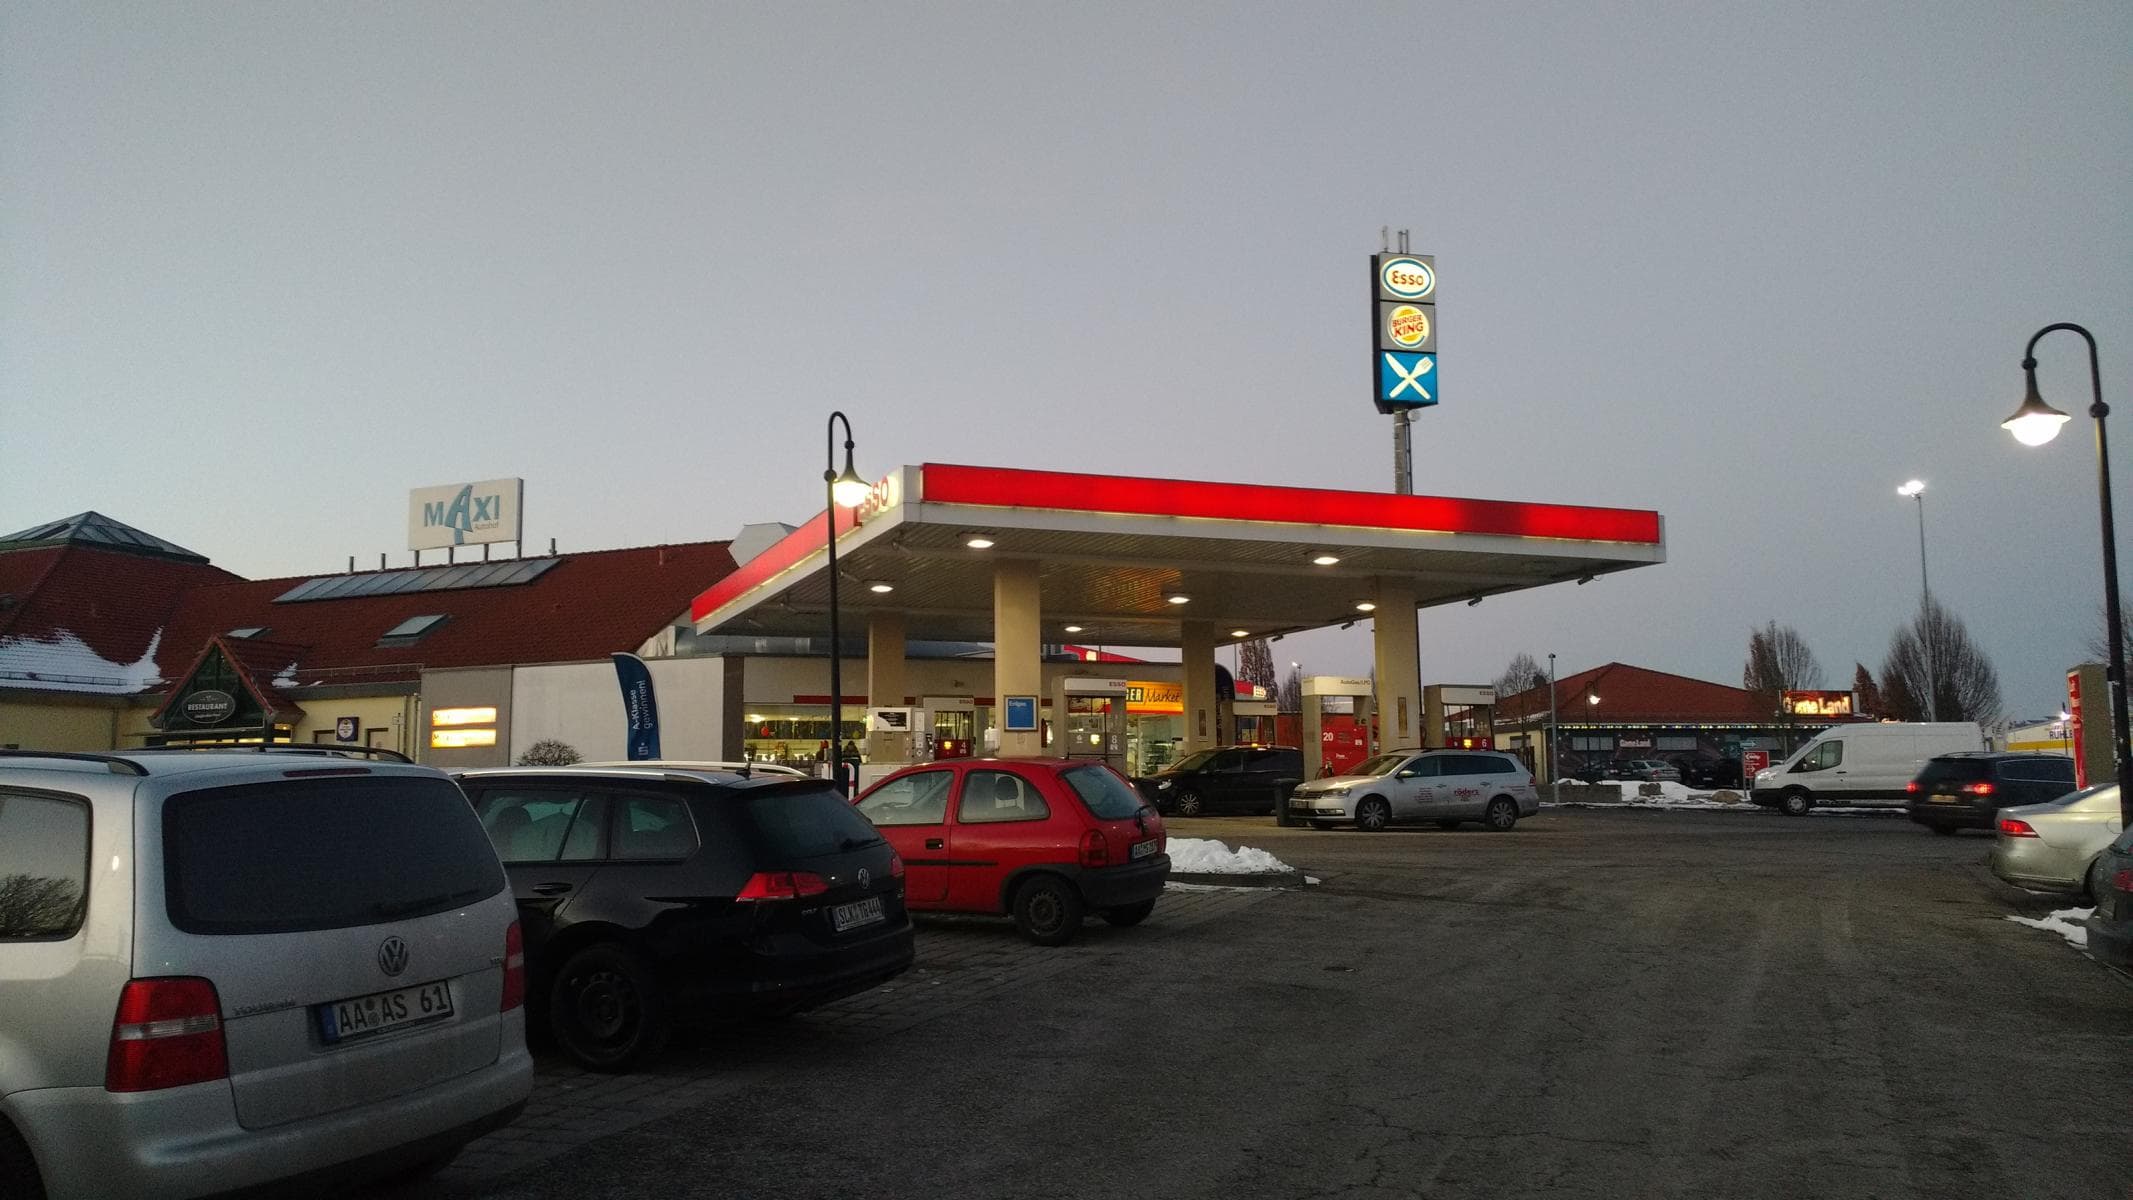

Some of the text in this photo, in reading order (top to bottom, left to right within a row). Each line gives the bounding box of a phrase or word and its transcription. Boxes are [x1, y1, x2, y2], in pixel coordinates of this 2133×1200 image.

[1392, 314, 1423, 328] BURGER
[1394, 322, 1424, 338] KING
[424, 485, 500, 545] MAXI
[1144, 688, 1181, 704] Market
[187, 703, 228, 711] RESTAURANT
[630, 689, 640, 730] A-Klasse
[1818, 695, 1851, 714] Land
[1111, 734, 1118, 745] 8
[1322, 731, 1334, 742] 20
[339, 985, 447, 1033] AA AS 61
